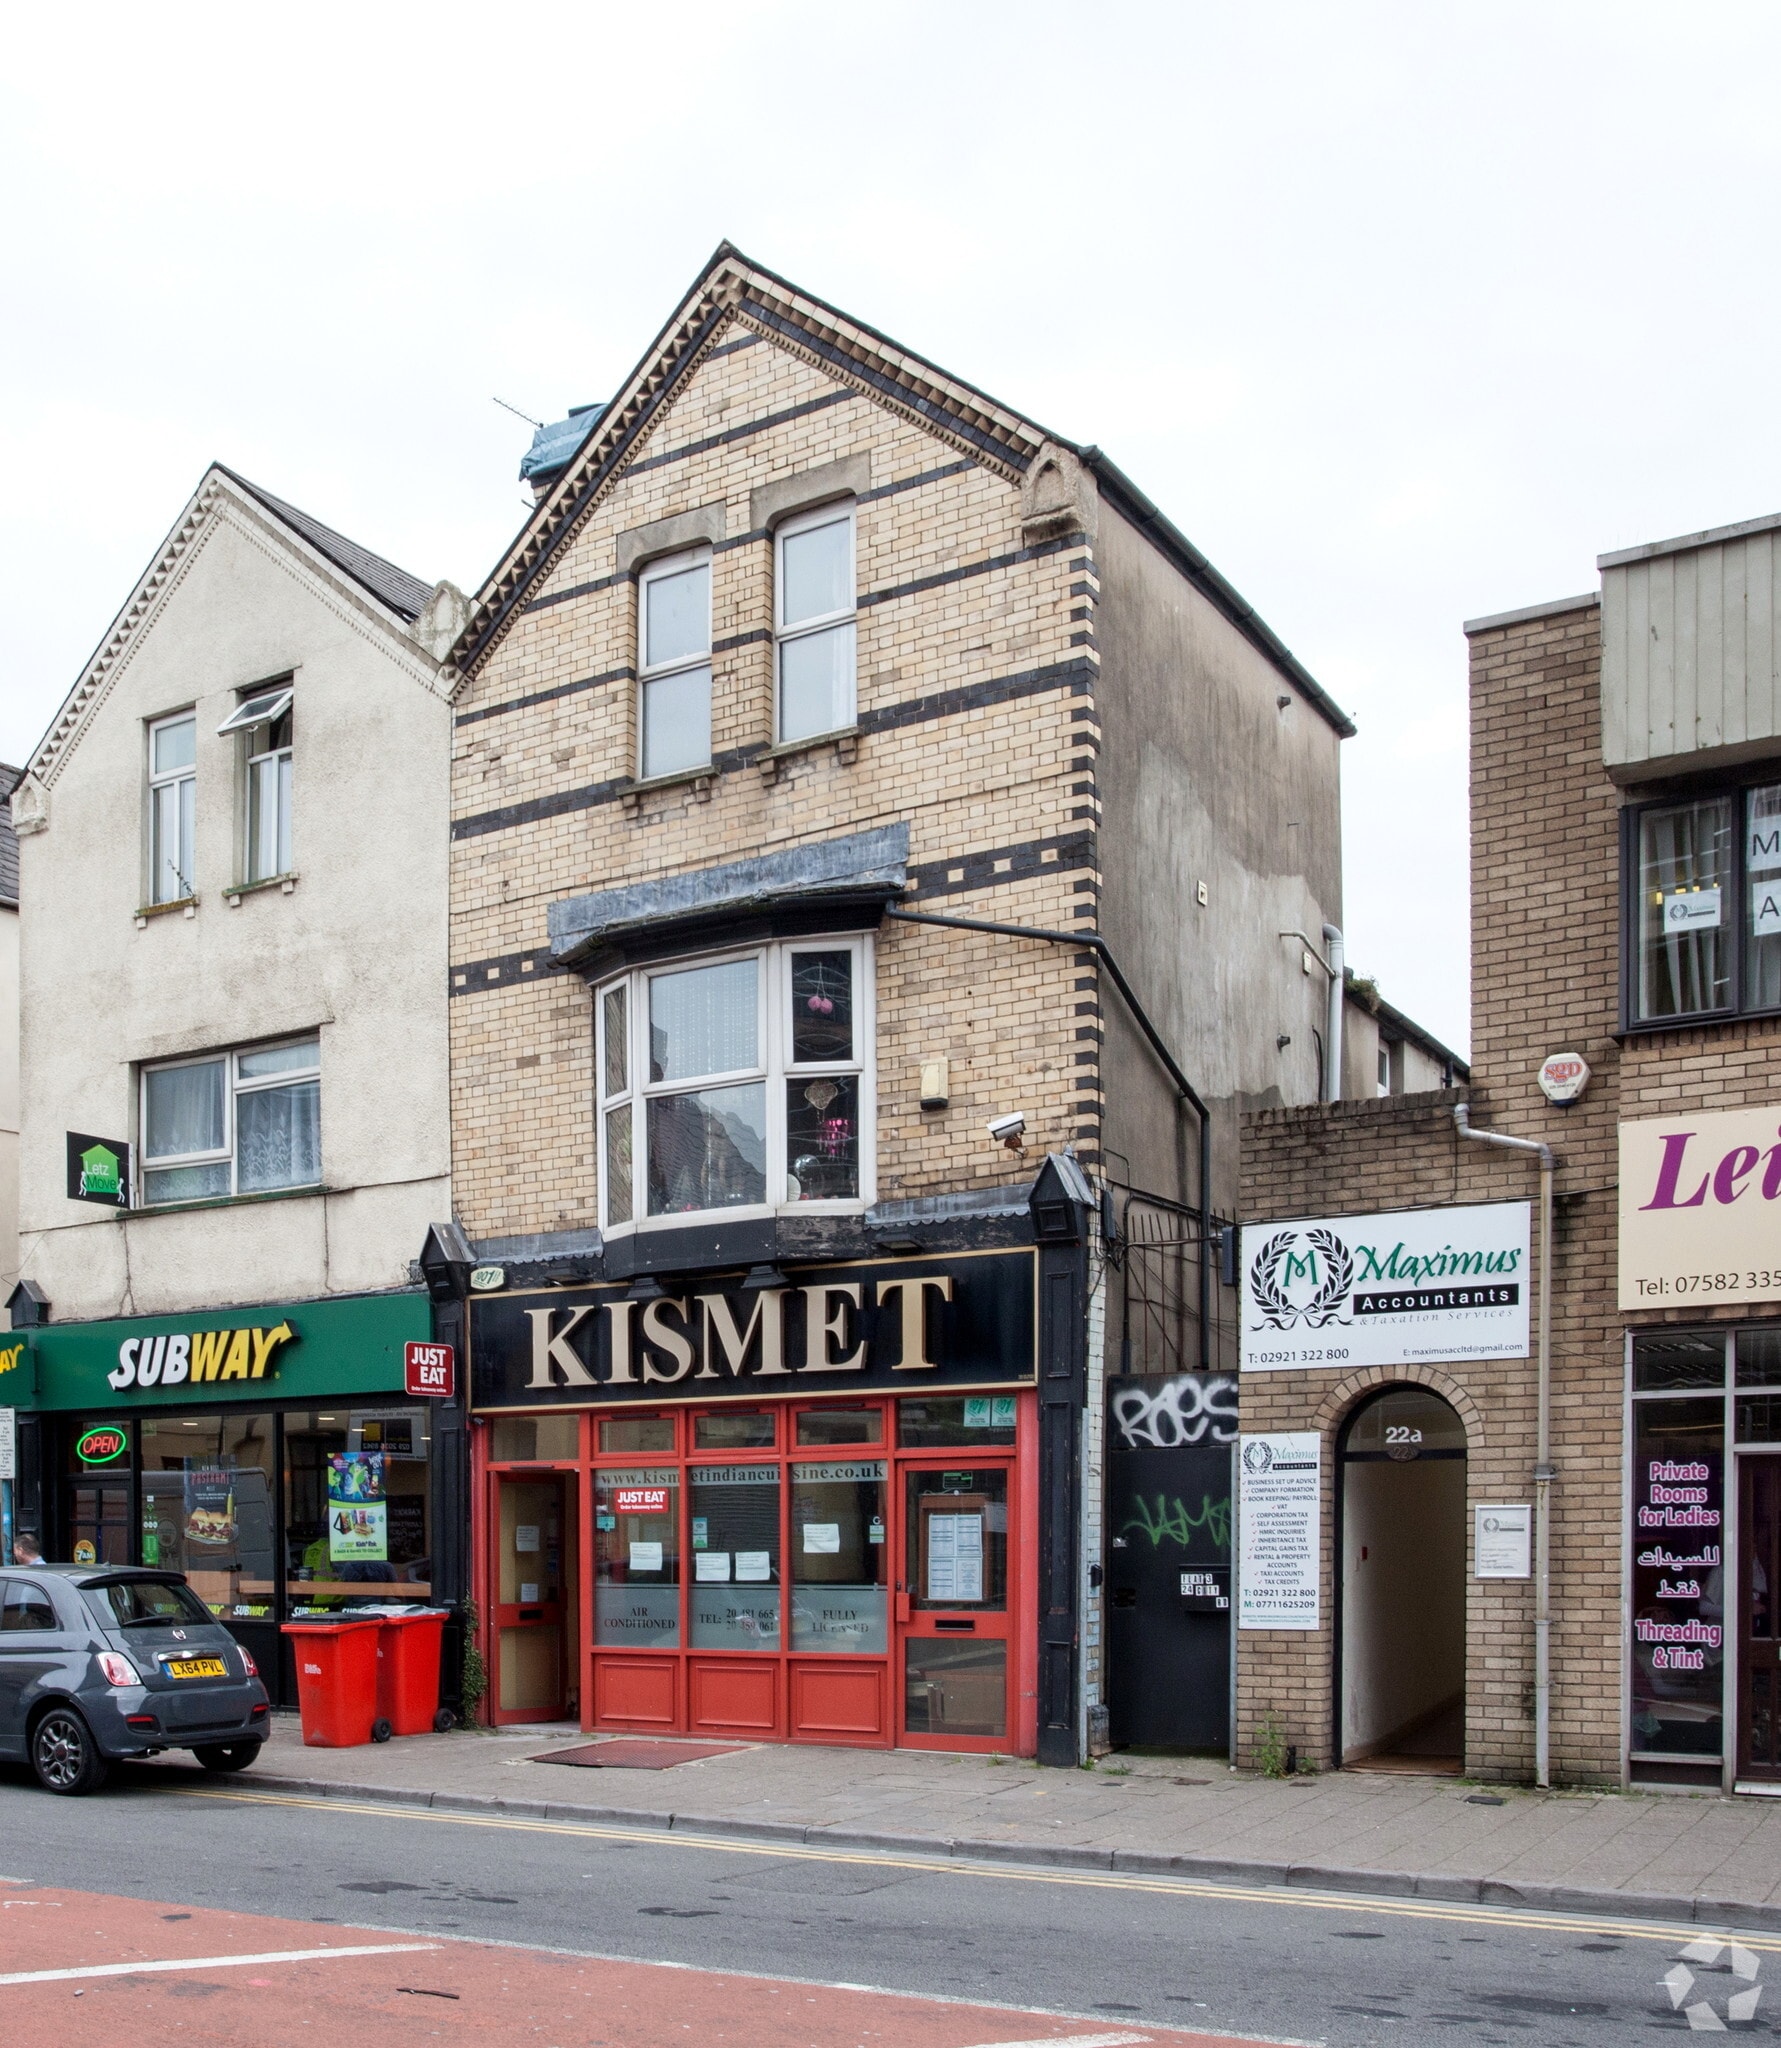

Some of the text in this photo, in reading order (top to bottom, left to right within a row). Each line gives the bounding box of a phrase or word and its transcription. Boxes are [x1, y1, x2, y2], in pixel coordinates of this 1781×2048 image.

[85, 1160, 110, 1176] Letz
[86, 1175, 117, 1190] Move
[1282, 1249, 1319, 1287] M
[1354, 1241, 1522, 1288] Maximus
[1635, 1276, 1670, 1296] Tel:
[1675, 1273, 1740, 1293] 07582
[1361, 1287, 1510, 1310] Accountants
[1447, 1307, 1514, 1321] Services
[523, 1275, 953, 1390] KISMET
[107, 1318, 297, 1391] SUBWAY
[411, 1346, 447, 1366] JUST
[1247, 1348, 1350, 1364] T: 02921 322 800
[1402, 1343, 1524, 1357] E: maximusaccltd@gmail.com
[420, 1365, 447, 1385] EAT
[1385, 1426, 1423, 1443] 22a
[83, 1436, 119, 1454] OPEN
[1272, 1447, 1318, 1461] Maximus
[1649, 1460, 1709, 1481] Private
[617, 1491, 666, 1503] JUST EAT
[1650, 1484, 1708, 1503] Rooms
[1638, 1506, 1720, 1526] for Ladies
[1637, 1546, 1720, 1571] للسيدات
[1182, 1586, 1193, 1594] 24
[1656, 1579, 1700, 1598] فقط
[232, 1604, 270, 1617] SUBWAY
[631, 1607, 648, 1617] AIR
[699, 1613, 722, 1625] TEL:
[726, 1608, 737, 1618] 20
[758, 1609, 774, 1619] 665
[823, 1609, 858, 1620] FULLY
[604, 1619, 676, 1630] CONDITIONED
[760, 1621, 774, 1632] 061
[812, 1622, 869, 1633] LICENSED
[1635, 1619, 1722, 1647] Threading
[1653, 1646, 1704, 1670] & Tint
[173, 1659, 224, 1676] LX64 PVL
